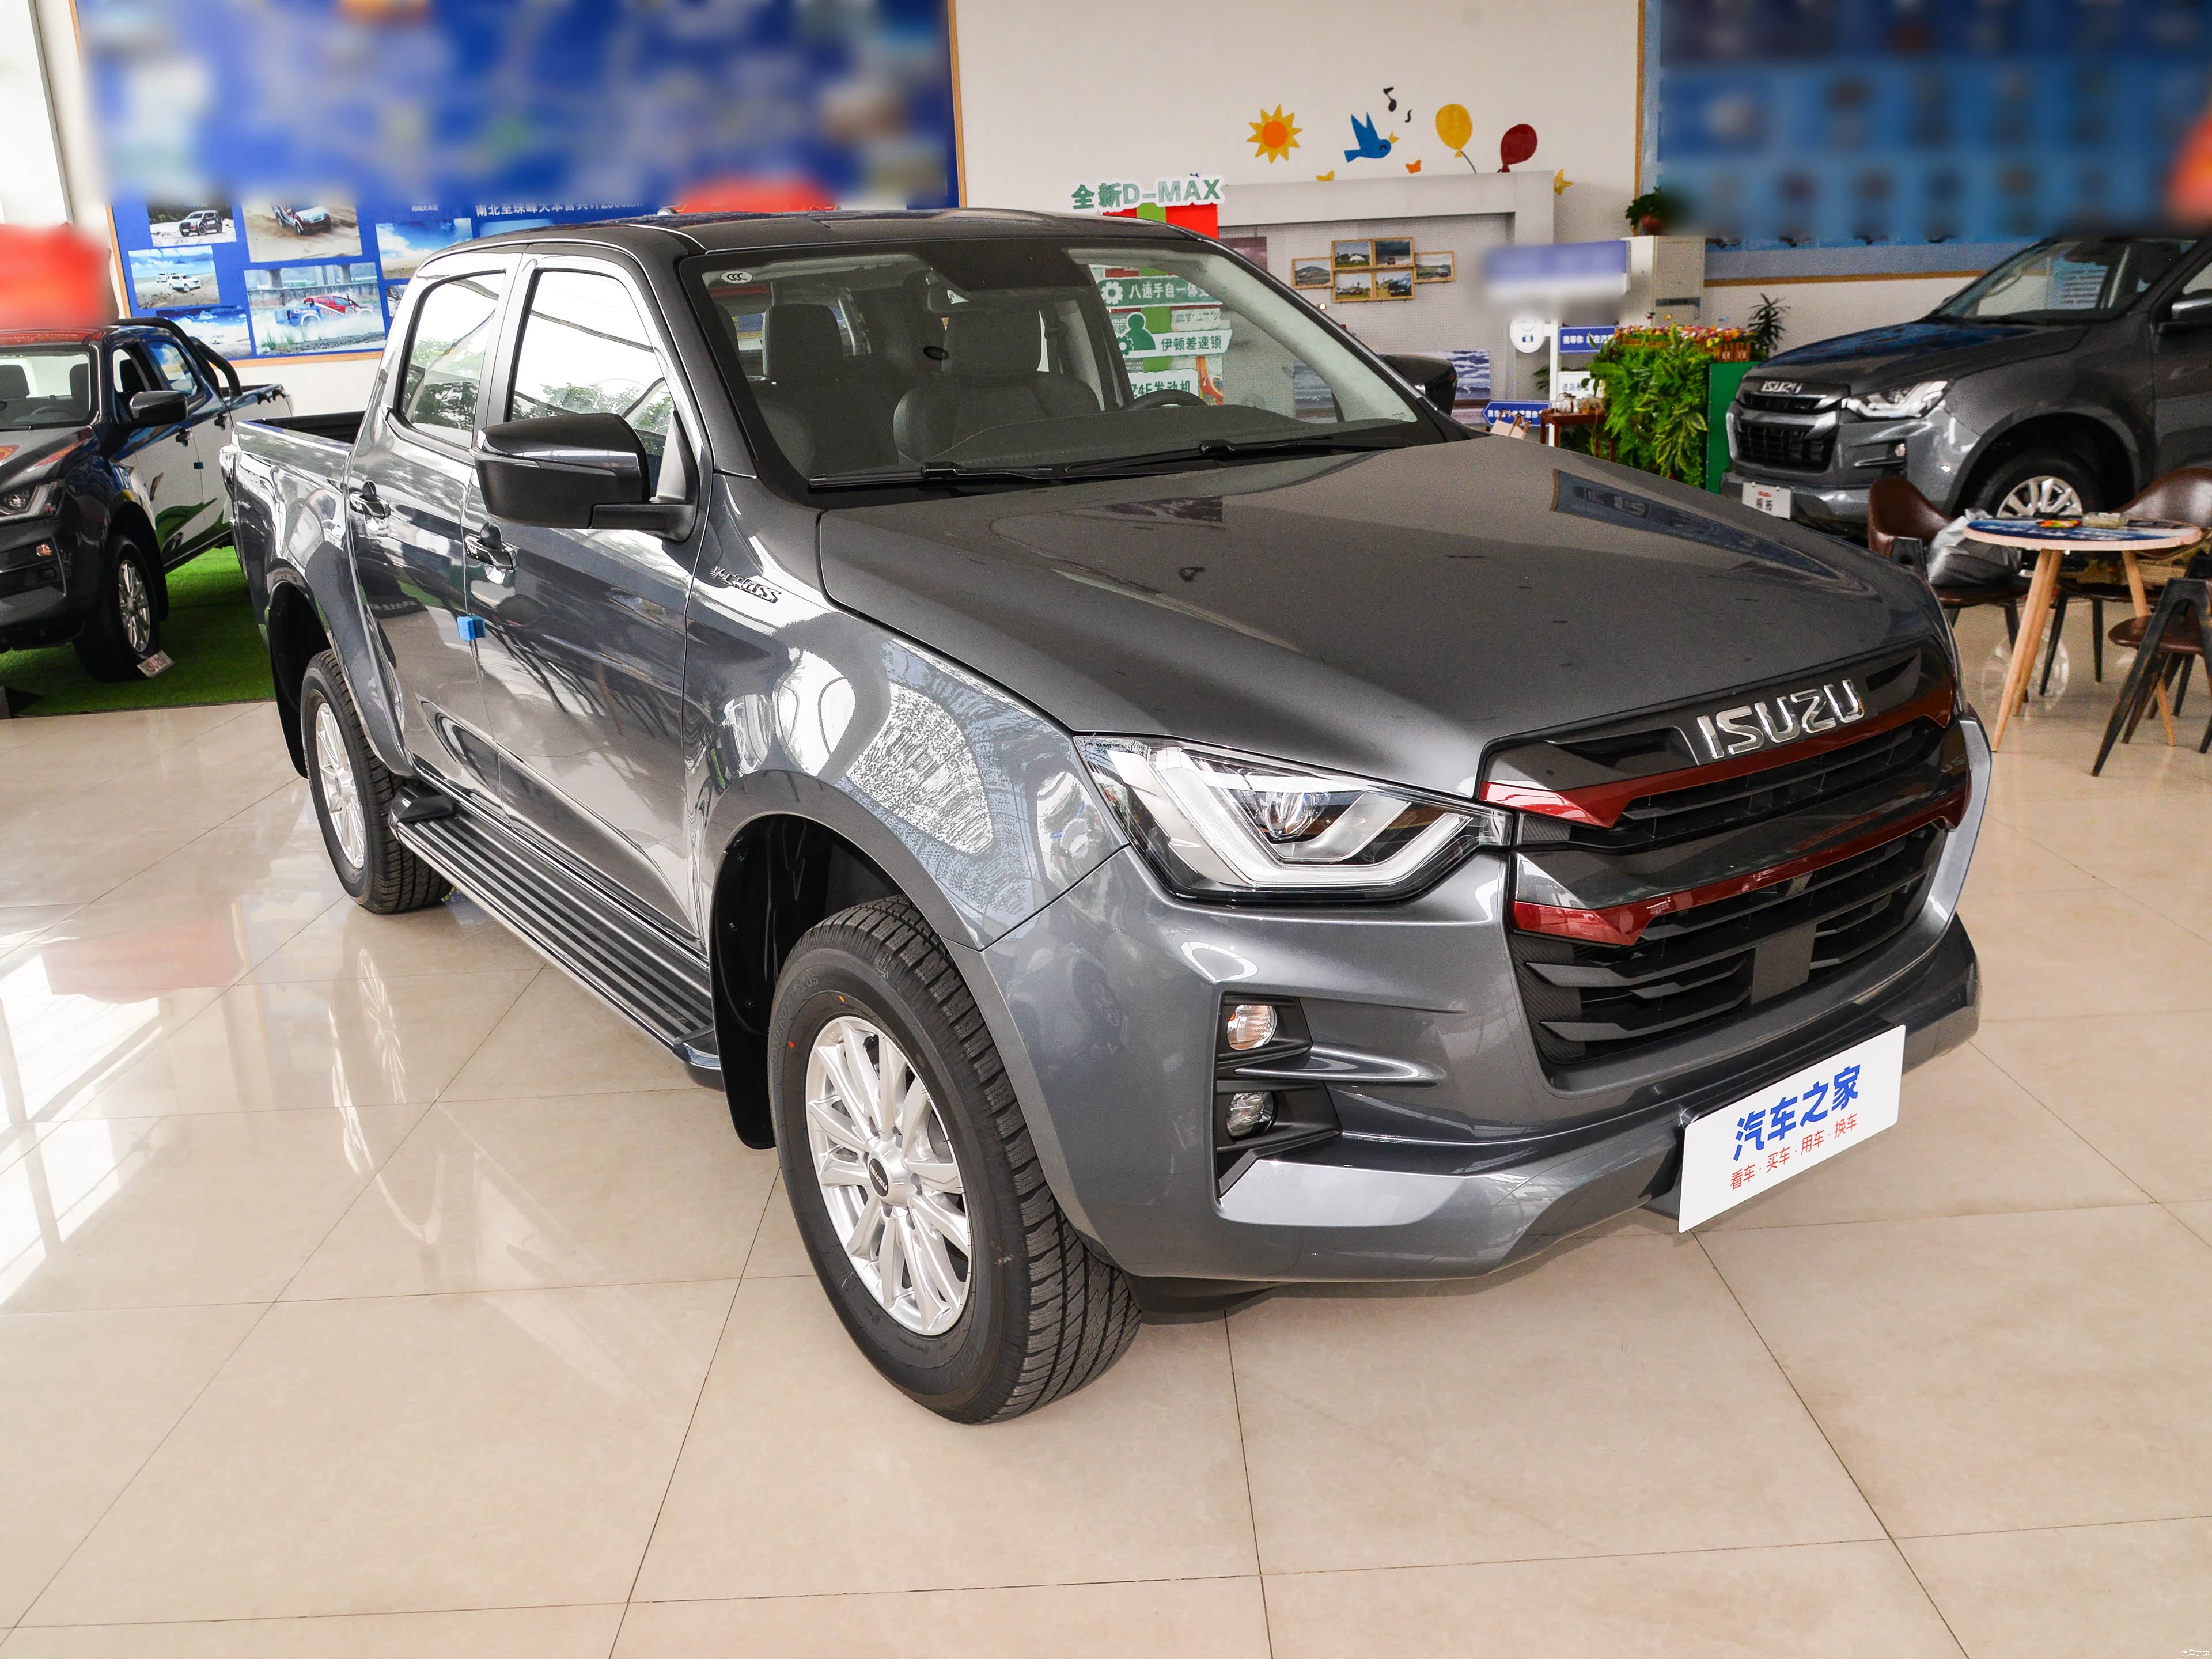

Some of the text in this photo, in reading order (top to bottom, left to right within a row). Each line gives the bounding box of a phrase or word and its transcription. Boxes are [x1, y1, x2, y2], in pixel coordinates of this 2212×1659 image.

[1071, 179, 1221, 209] 全新D-MAX
[1161, 335, 1222, 351] 伊顿差速锁
[1761, 380, 1804, 394] ISUZU
[1696, 677, 1865, 760] ISUZU
[1733, 1064, 1861, 1161] 汽车之家
[869, 1164, 888, 1191] ISUZU
